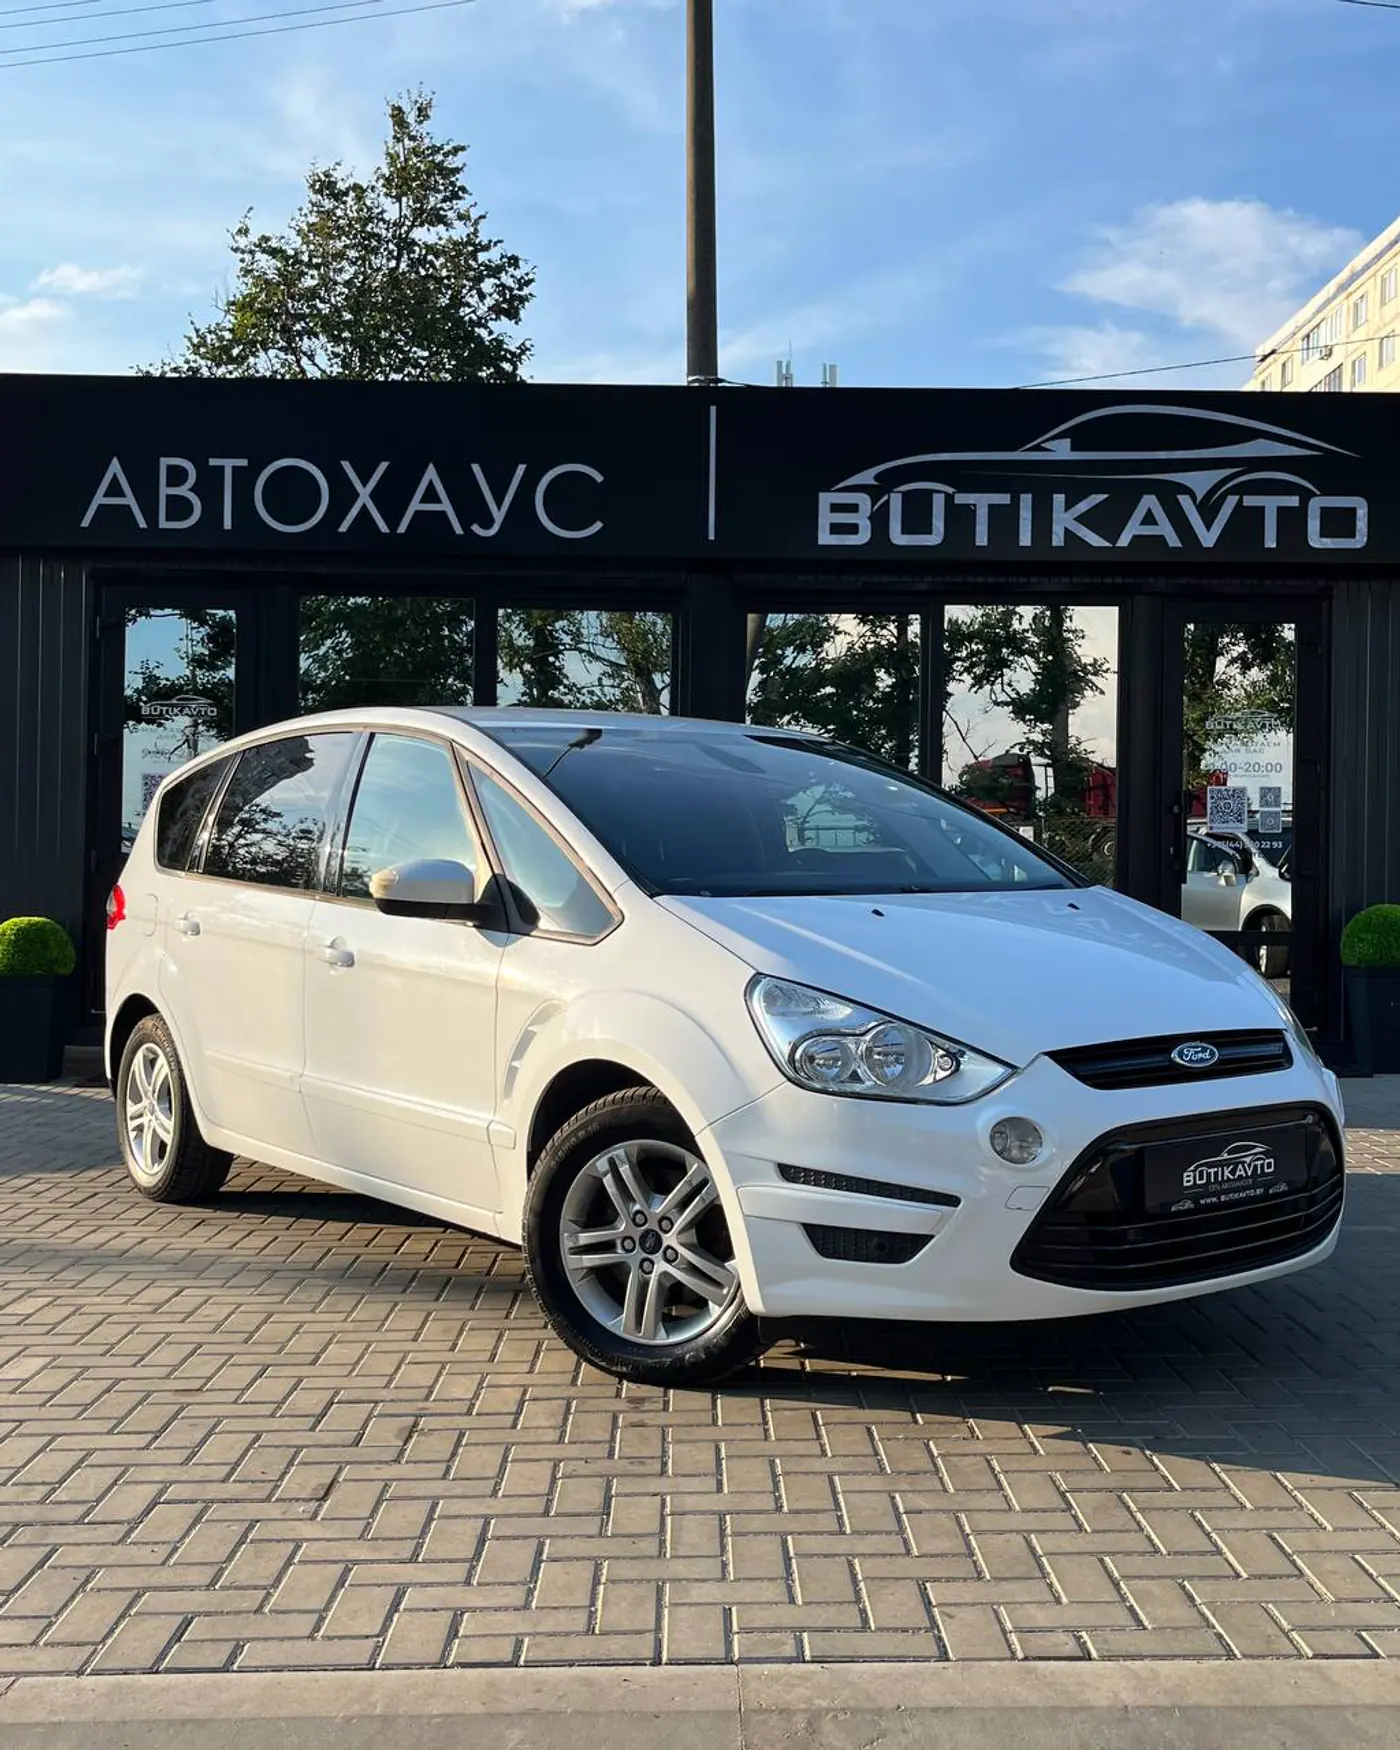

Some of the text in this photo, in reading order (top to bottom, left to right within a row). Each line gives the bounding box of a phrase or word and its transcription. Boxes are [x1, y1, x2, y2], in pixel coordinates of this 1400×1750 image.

[80, 456, 605, 540] АВТОХАУС
[818, 491, 1369, 549] BUTIKAVTO
[141, 706, 218, 717] BUTIKAVTO
[1182, 1047, 1211, 1061] Ford
[1183, 1158, 1275, 1187] BUTIKAVTO
